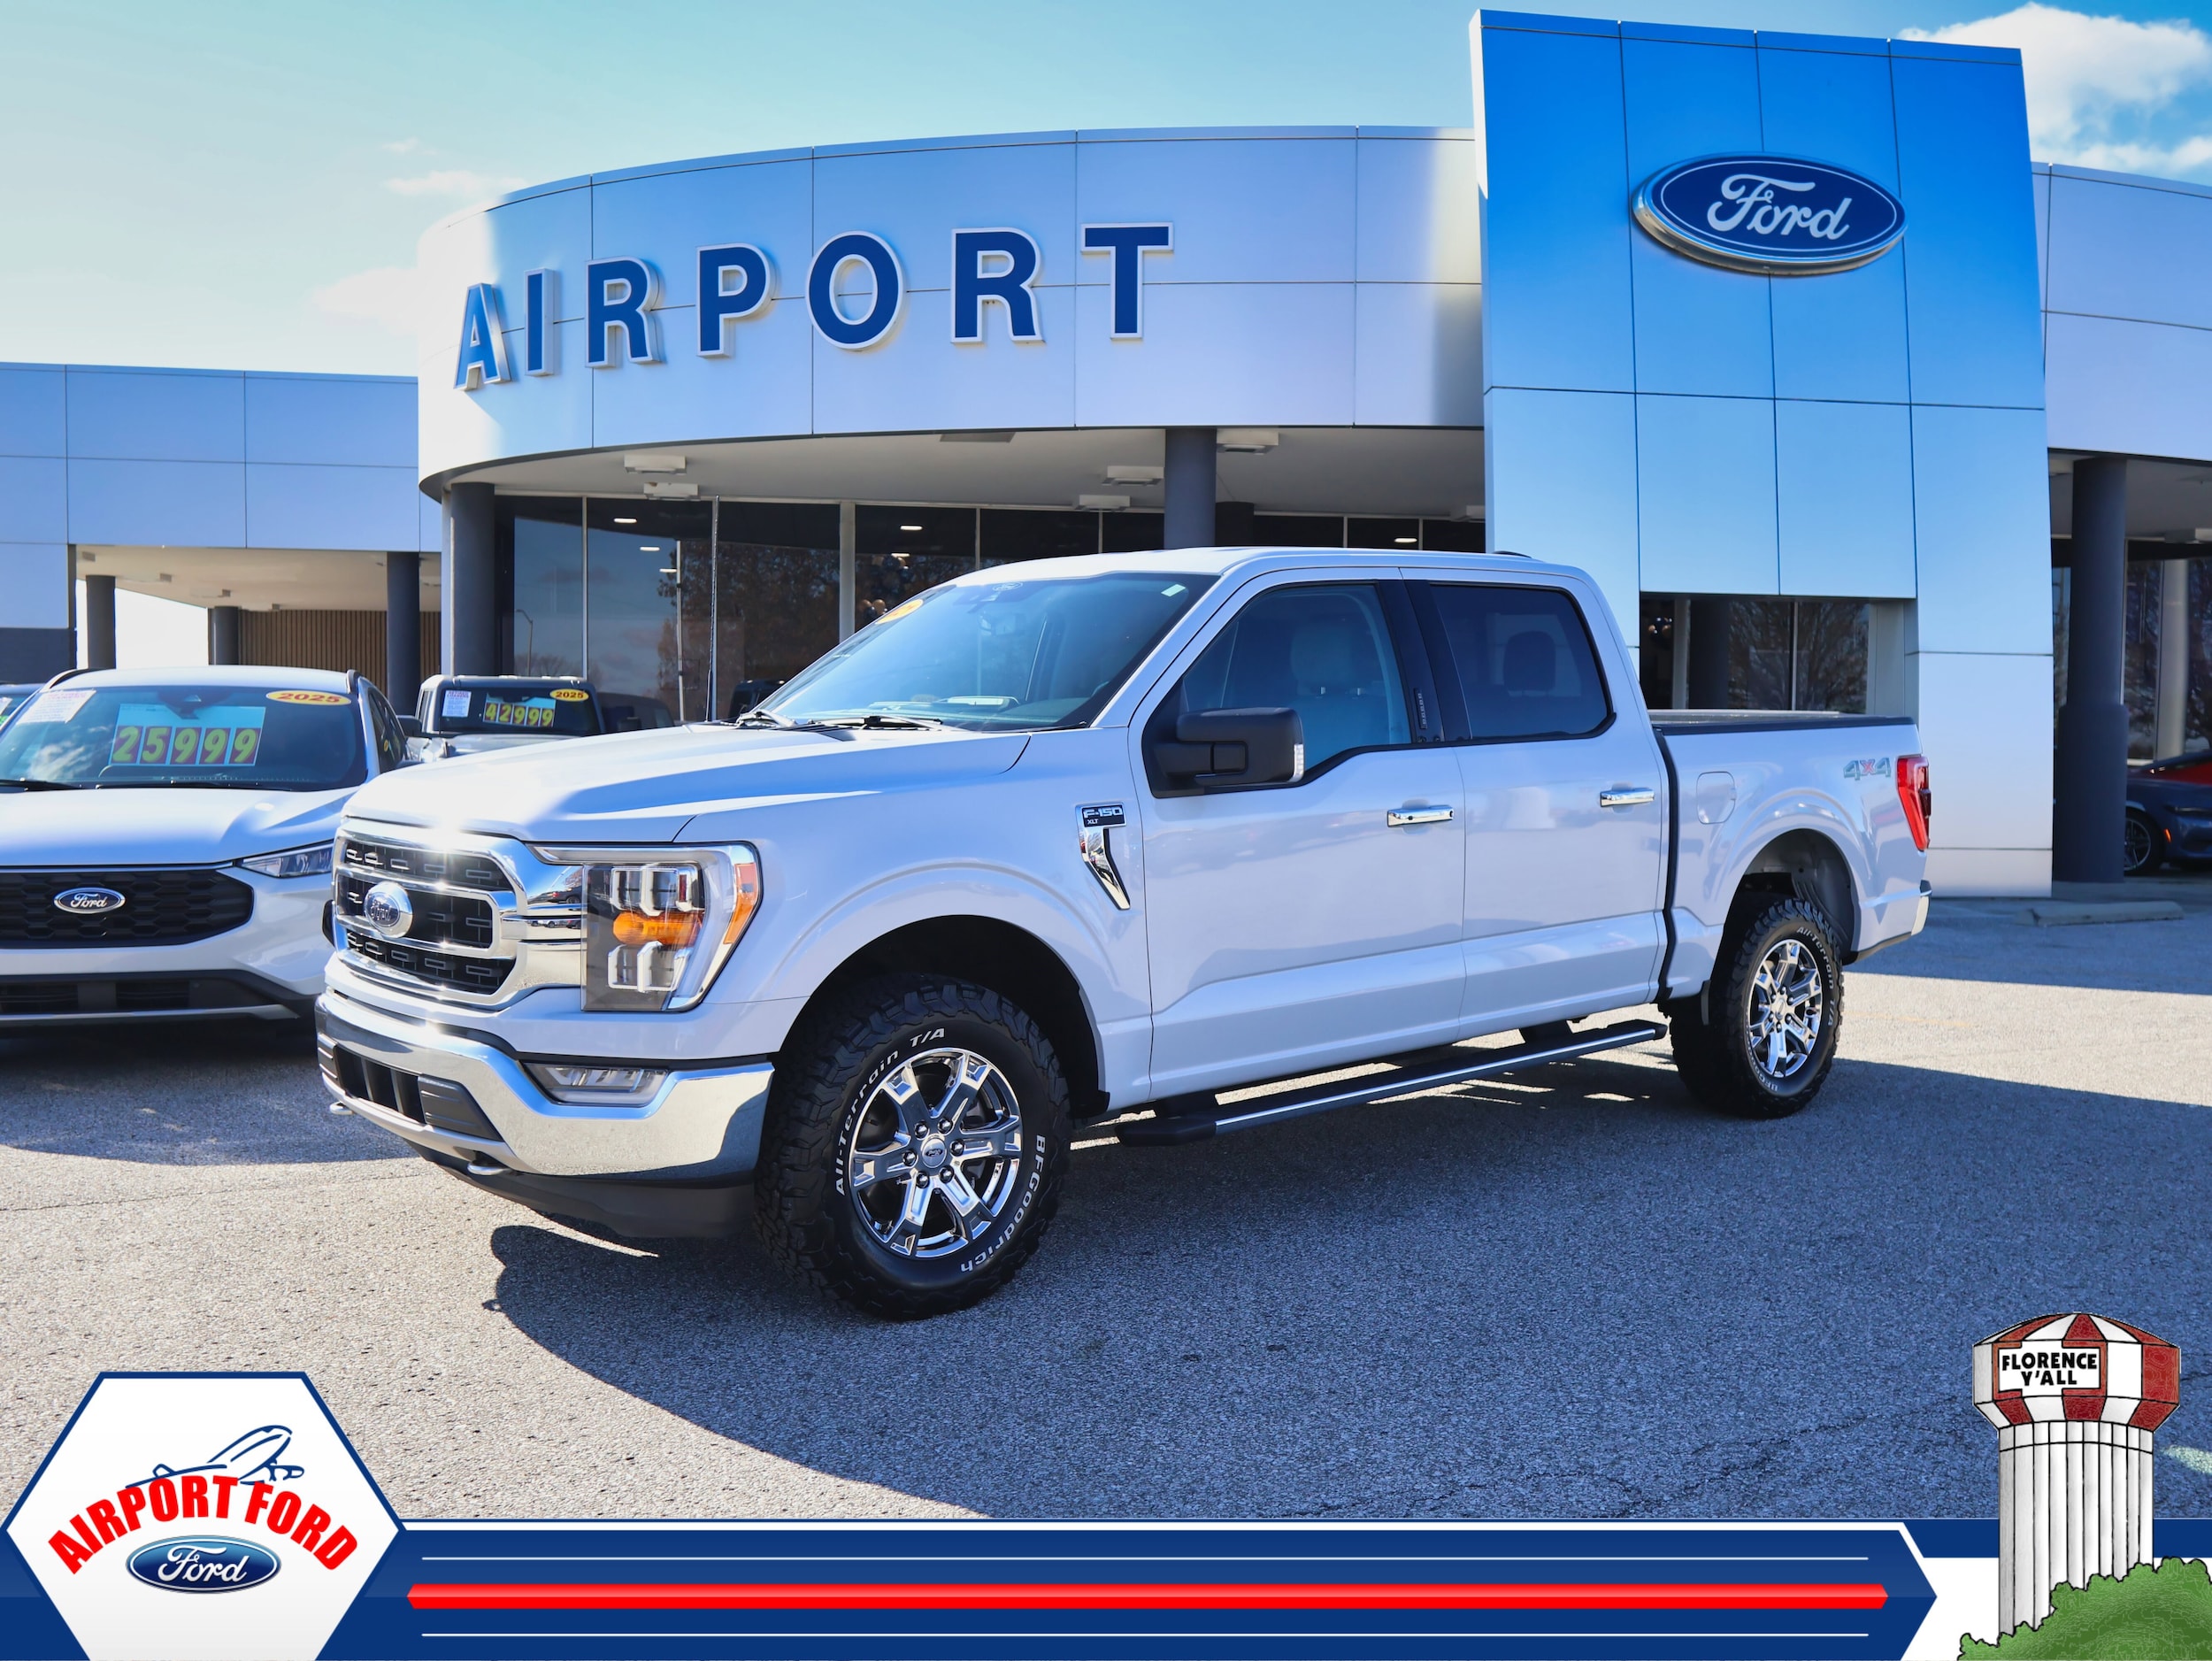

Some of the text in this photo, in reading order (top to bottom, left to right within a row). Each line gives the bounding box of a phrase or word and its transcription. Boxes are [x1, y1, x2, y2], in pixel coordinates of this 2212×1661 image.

[1707, 173, 1853, 240] Ford
[453, 222, 1174, 391] AIRPORT
[277, 692, 342, 704] 2025
[485, 704, 554, 727] 42999
[111, 726, 257, 763] 25999
[1084, 807, 1123, 818] F-150
[70, 893, 108, 907] Ford
[834, 1027, 945, 1196] All-Terrain T/A
[961, 1134, 1047, 1273] BFGoodrich
